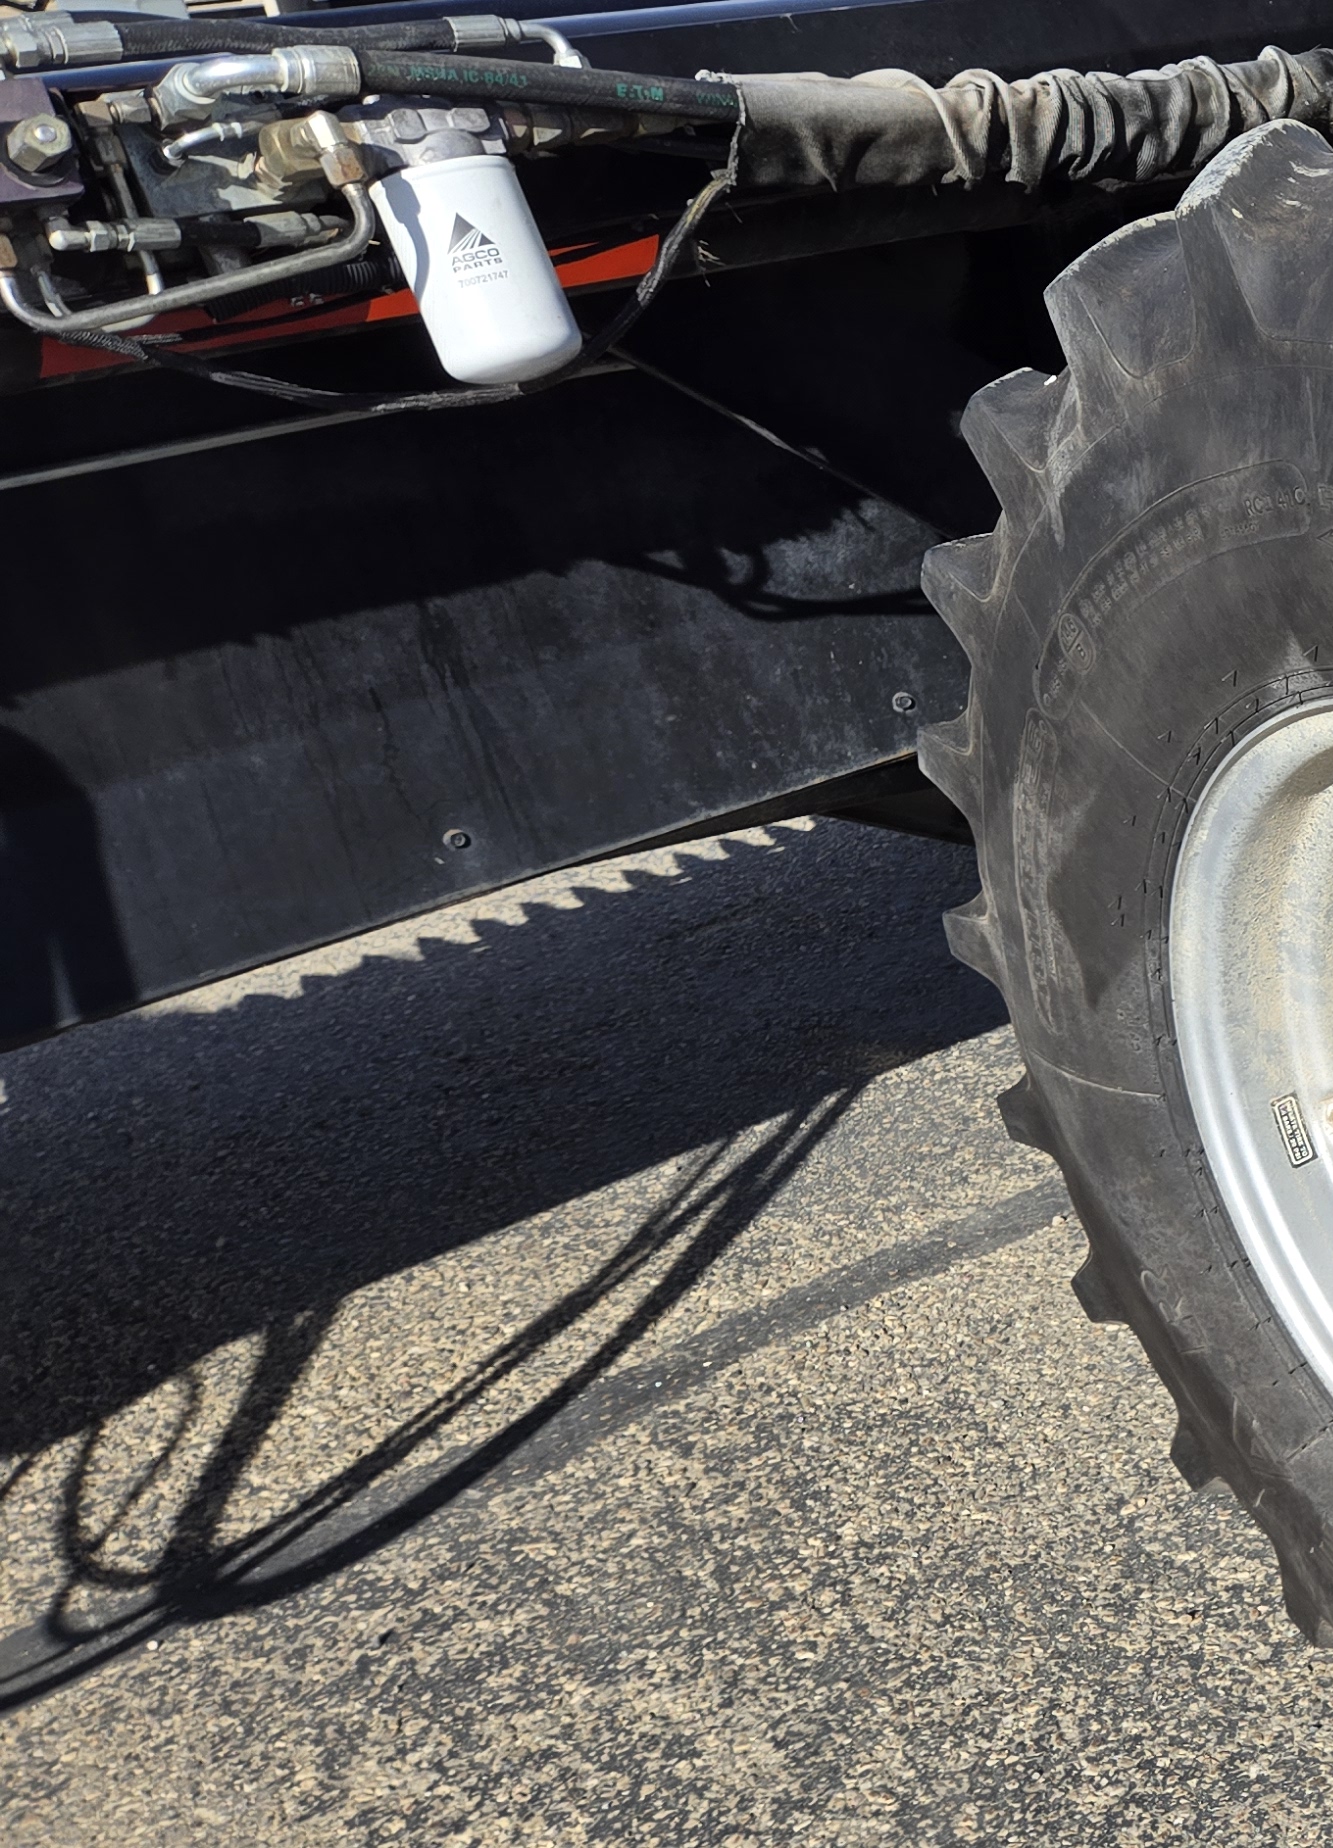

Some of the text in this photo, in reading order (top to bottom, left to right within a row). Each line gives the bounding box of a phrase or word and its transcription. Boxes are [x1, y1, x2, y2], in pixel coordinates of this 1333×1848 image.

[452, 248, 500, 266] AGCO
[453, 257, 503, 273] PARTS
[458, 270, 509, 288] 700721747
